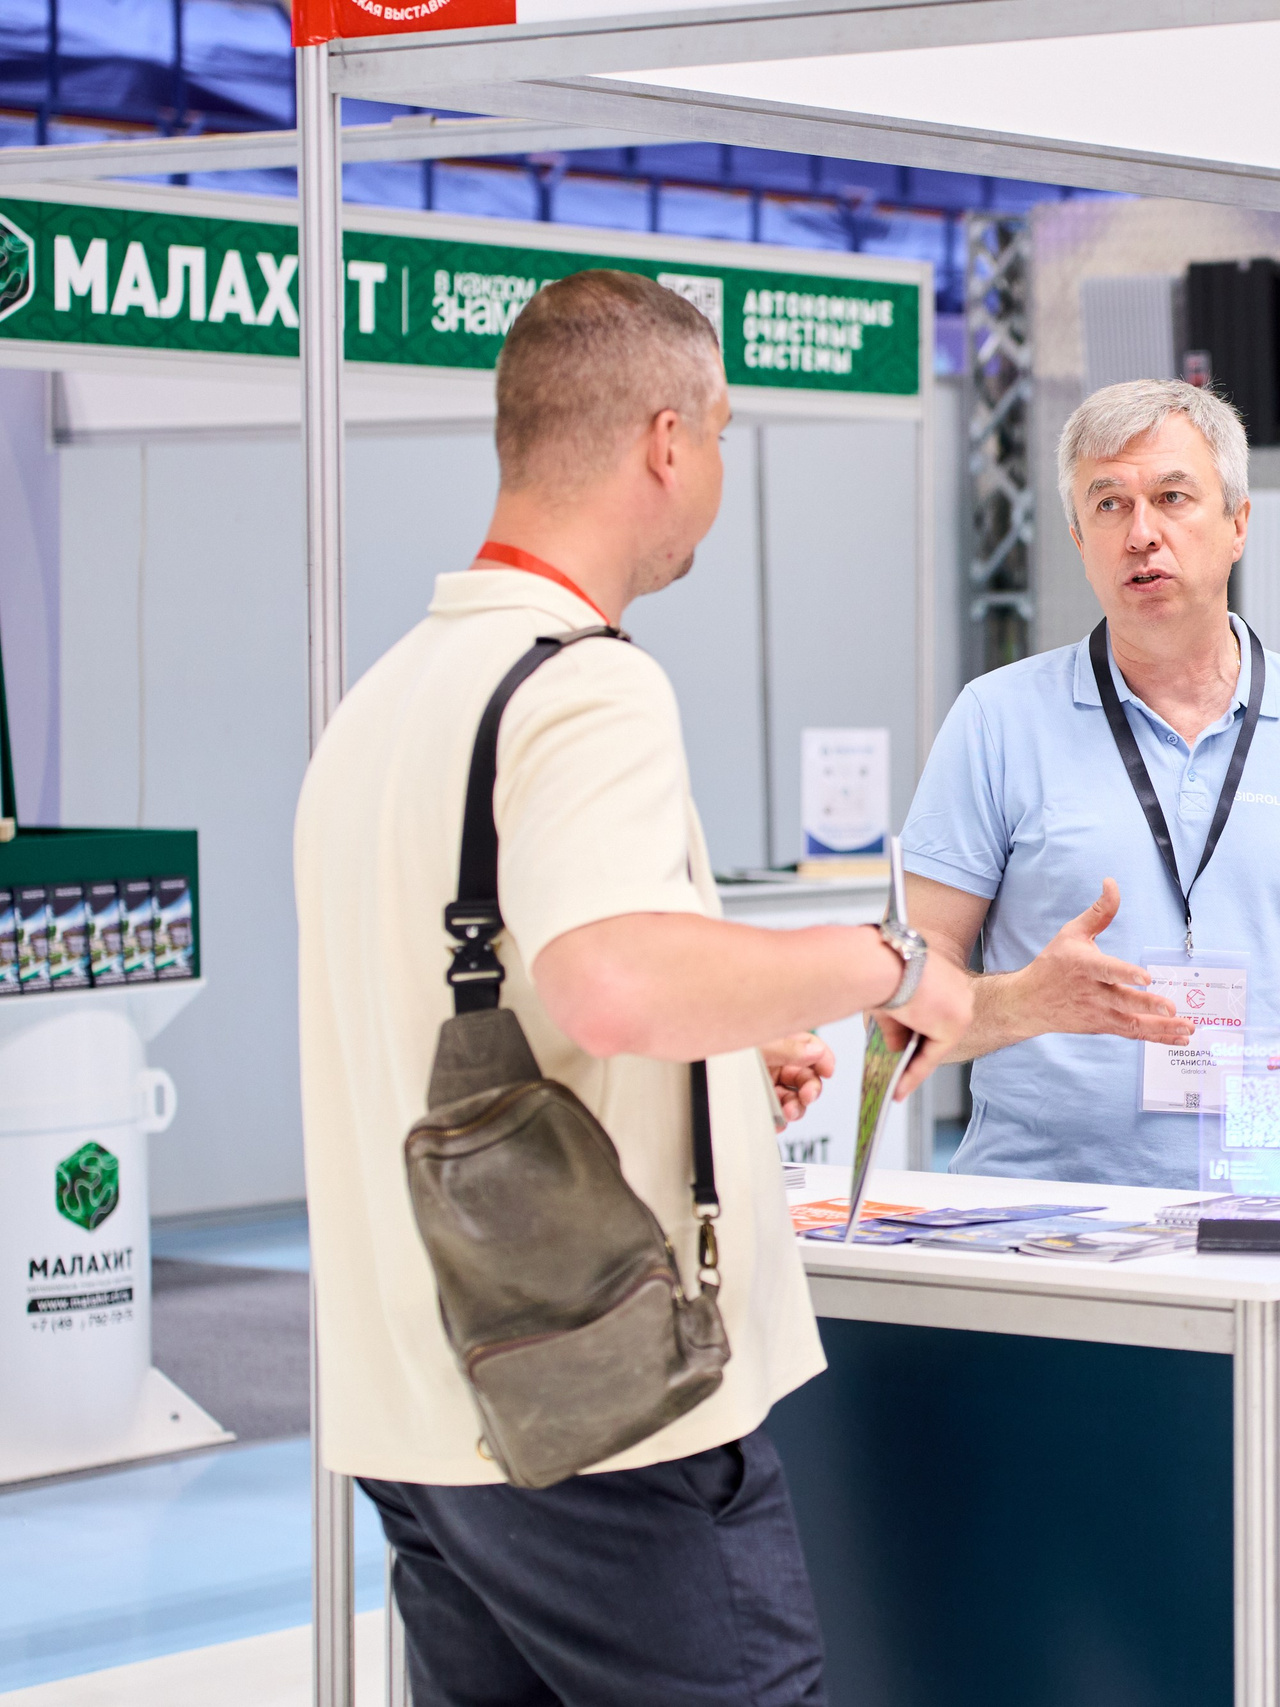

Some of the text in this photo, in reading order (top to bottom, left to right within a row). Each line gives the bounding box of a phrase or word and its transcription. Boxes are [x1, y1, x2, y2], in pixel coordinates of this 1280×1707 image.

[352, 0, 451, 20] КАЯ ВЫСТАВК
[54, 235, 387, 335] МАЛАХТ
[743, 289, 893, 327] АВТОНОМНЫЕ
[743, 314, 863, 350] ОЧИСТНЫЕ
[744, 341, 853, 374] СИСТЕМЫ
[1168, 1049, 1222, 1058] ПИВОВАРЧ
[28, 1248, 133, 1278] МАЛАХИТ
